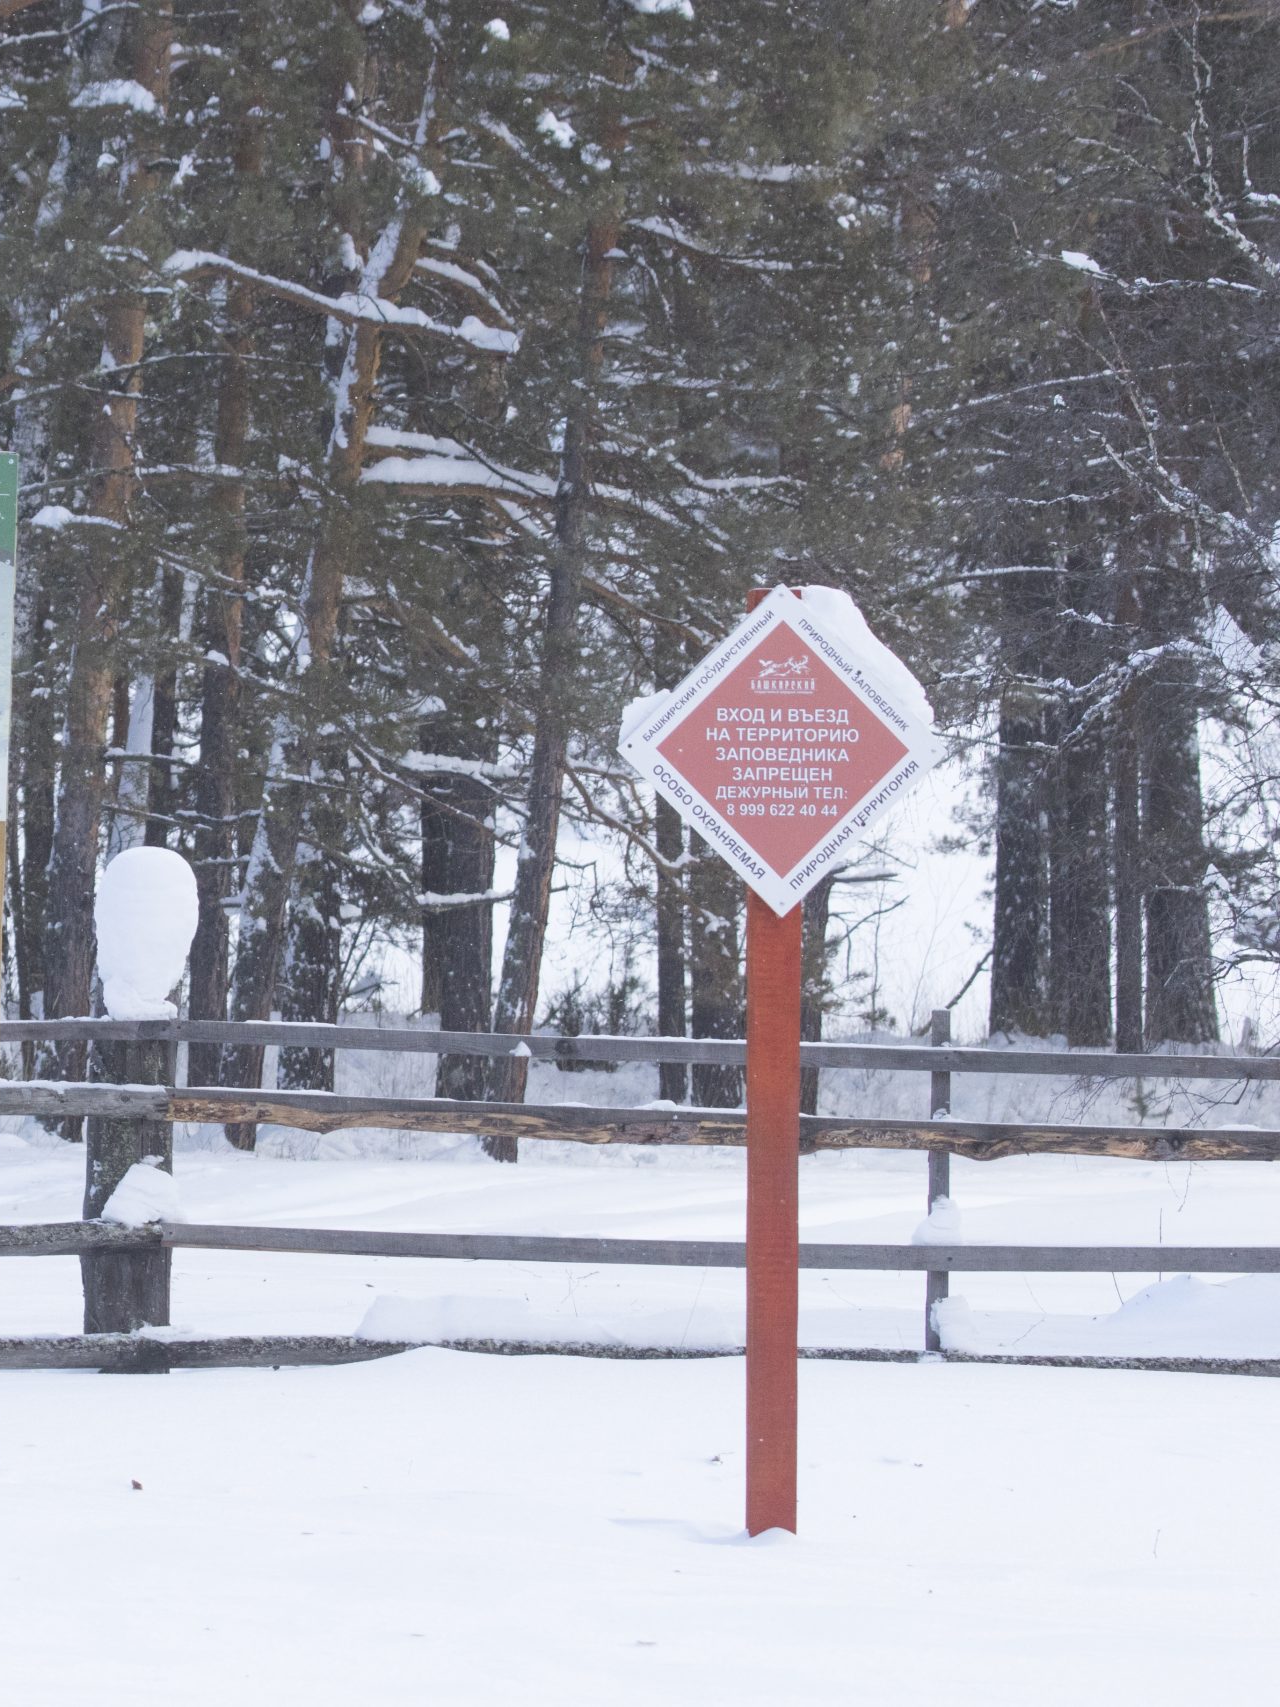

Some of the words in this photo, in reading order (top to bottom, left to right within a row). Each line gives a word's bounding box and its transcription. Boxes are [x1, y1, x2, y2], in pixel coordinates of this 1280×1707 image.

[643, 690, 697, 742] БАШКИРСКИЙ
[696, 610, 775, 691] ГОСУДАРСТВЕННЫЙ
[751, 679, 815, 689] БАШКИРСКИЙ
[798, 618, 853, 677] ПРИРОДНЫЙ
[850, 673, 910, 733] ЗАПОВЕДНИК
[716, 708, 765, 724] ВХОД
[771, 709, 782, 722] И
[788, 708, 849, 725] ВЪЕЗД
[706, 728, 730, 742] НА
[736, 728, 858, 743] ТЕРРИТОРИЮ
[716, 747, 849, 764] ЗАПОВЕДНИКА
[732, 767, 832, 784] ЗАПРЕЩЕН
[716, 785, 808, 801] ДЕЖУРНЫЙ
[813, 787, 848, 799] ТЕЛ:
[727, 805, 734, 815] 8
[739, 805, 765, 816] 999
[770, 806, 795, 816] 622
[800, 806, 816, 816] 40
[821, 806, 838, 816] 44
[653, 765, 693, 806] ОСОБО
[692, 804, 765, 879] ОХРАНЯЕМАЯ
[789, 826, 855, 890] ПРИРОДНАЯ
[851, 761, 919, 828] ТЕРРИТОРИЯ
